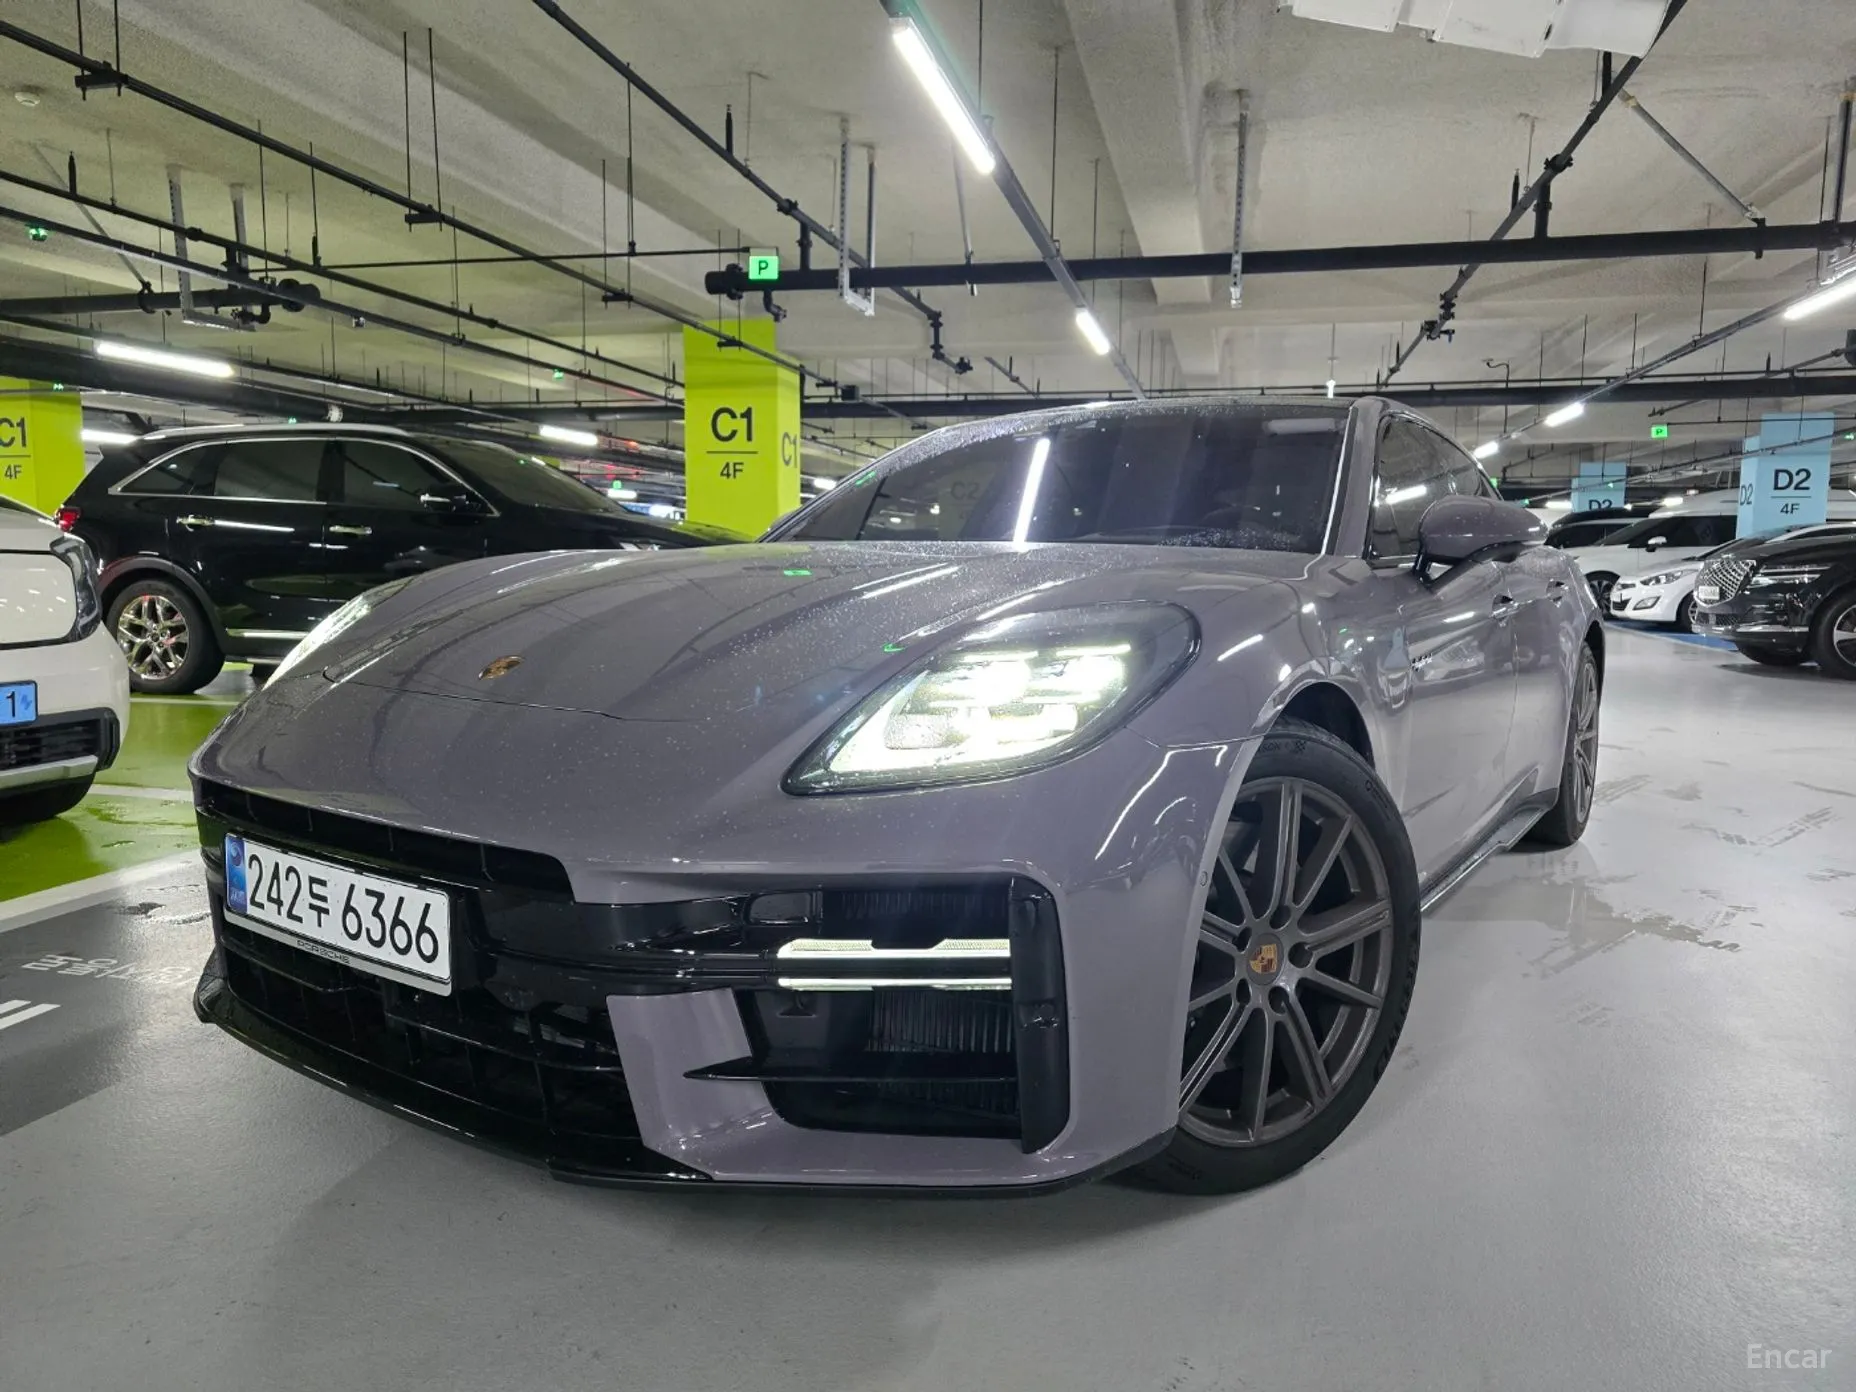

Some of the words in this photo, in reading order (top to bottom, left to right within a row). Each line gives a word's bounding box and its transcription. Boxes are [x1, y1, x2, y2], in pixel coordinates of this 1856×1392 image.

[758, 260, 769, 275] P
[0, 416, 27, 448] C1
[711, 407, 752, 442] C1
[782, 432, 798, 469] C1
[4, 463, 22, 480] 4F
[720, 462, 744, 479] 4F
[1773, 468, 1811, 491] D2
[1740, 483, 1753, 506] D2
[1780, 502, 1800, 515] 4F
[248, 854, 330, 928] 242두
[342, 883, 439, 964] 6366
